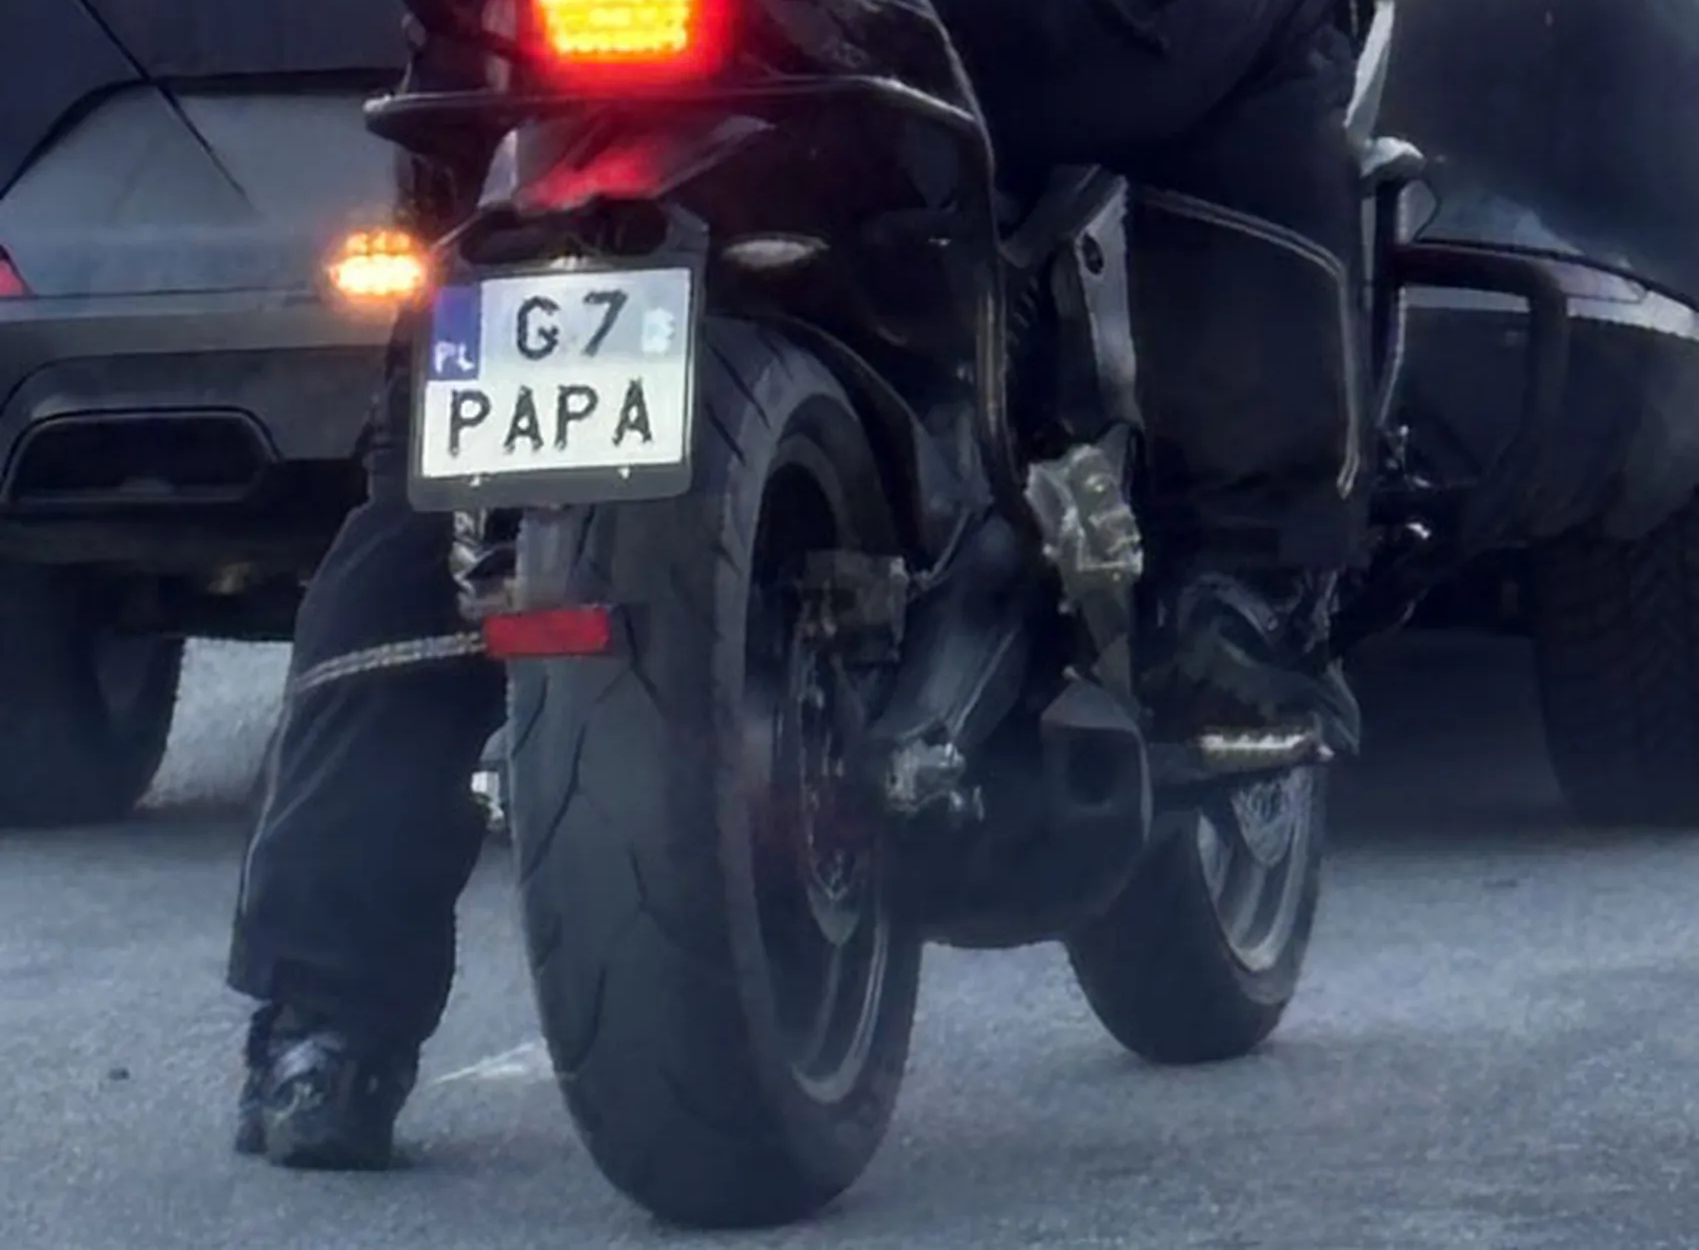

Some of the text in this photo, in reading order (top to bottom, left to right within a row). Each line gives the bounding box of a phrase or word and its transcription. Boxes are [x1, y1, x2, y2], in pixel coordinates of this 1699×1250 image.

[434, 340, 475, 374] PL
[516, 290, 628, 360] G7
[449, 376, 652, 457] PAPA
